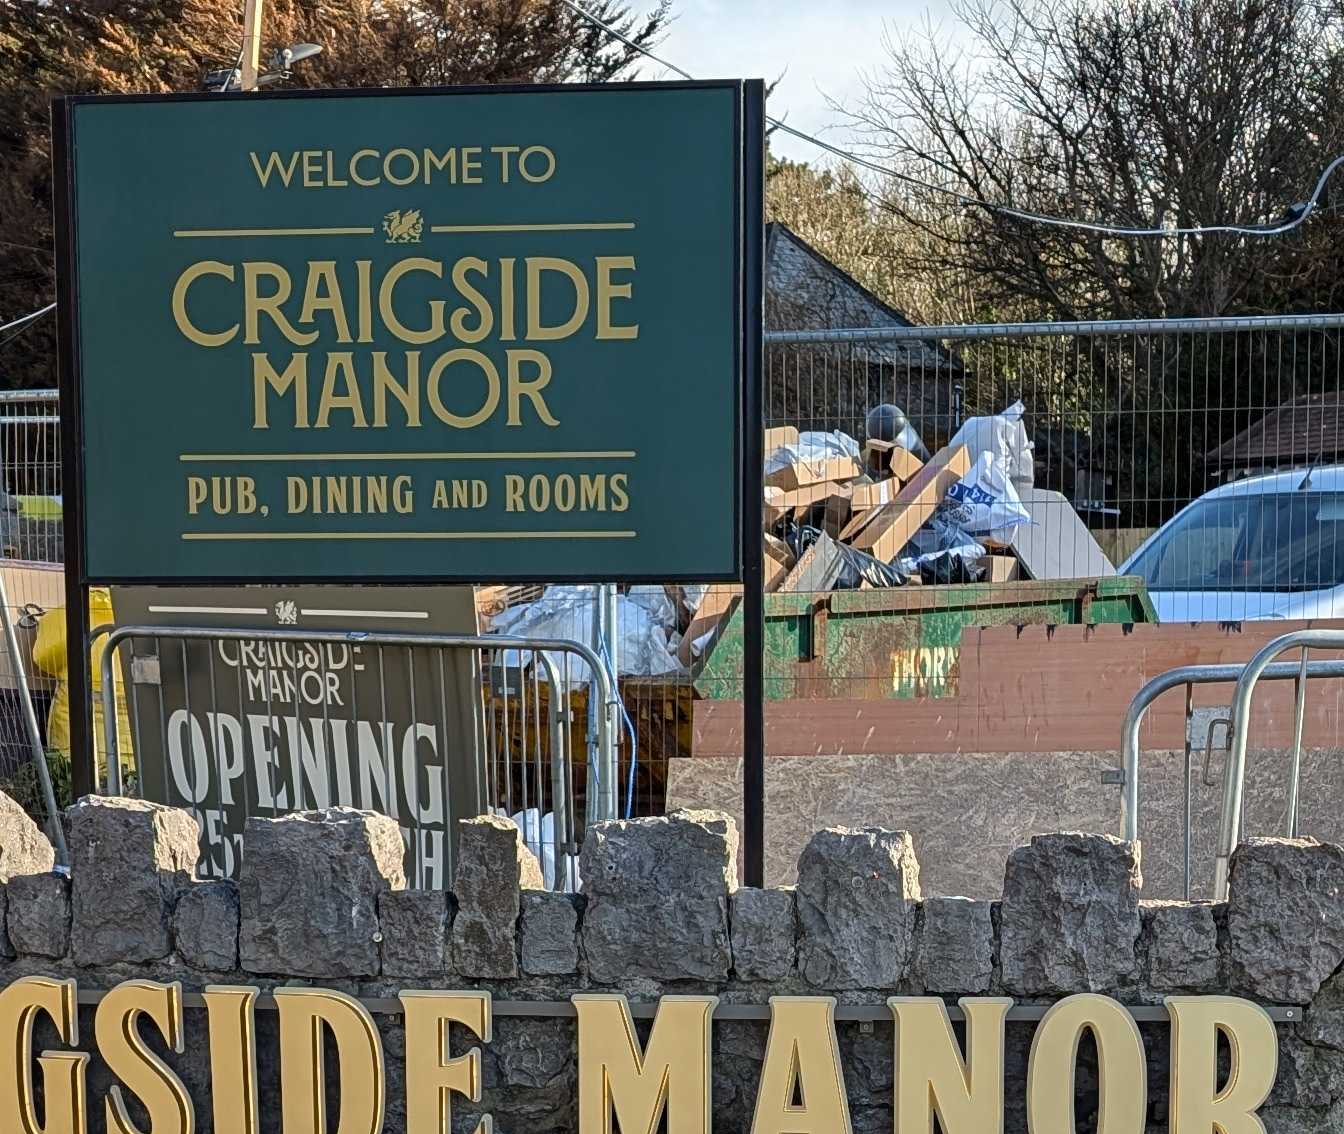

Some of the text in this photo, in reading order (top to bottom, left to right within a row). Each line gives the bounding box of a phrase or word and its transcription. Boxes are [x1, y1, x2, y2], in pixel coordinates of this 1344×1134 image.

[249, 145, 556, 189] WELCOME TO
[171, 255, 640, 347] CRAIGSIDE
[250, 347, 561, 430] MANOR
[186, 473, 630, 519] PUB, DINING AND ROOMS
[245, 669, 345, 706] MANOR
[167, 708, 444, 825] OPENING
